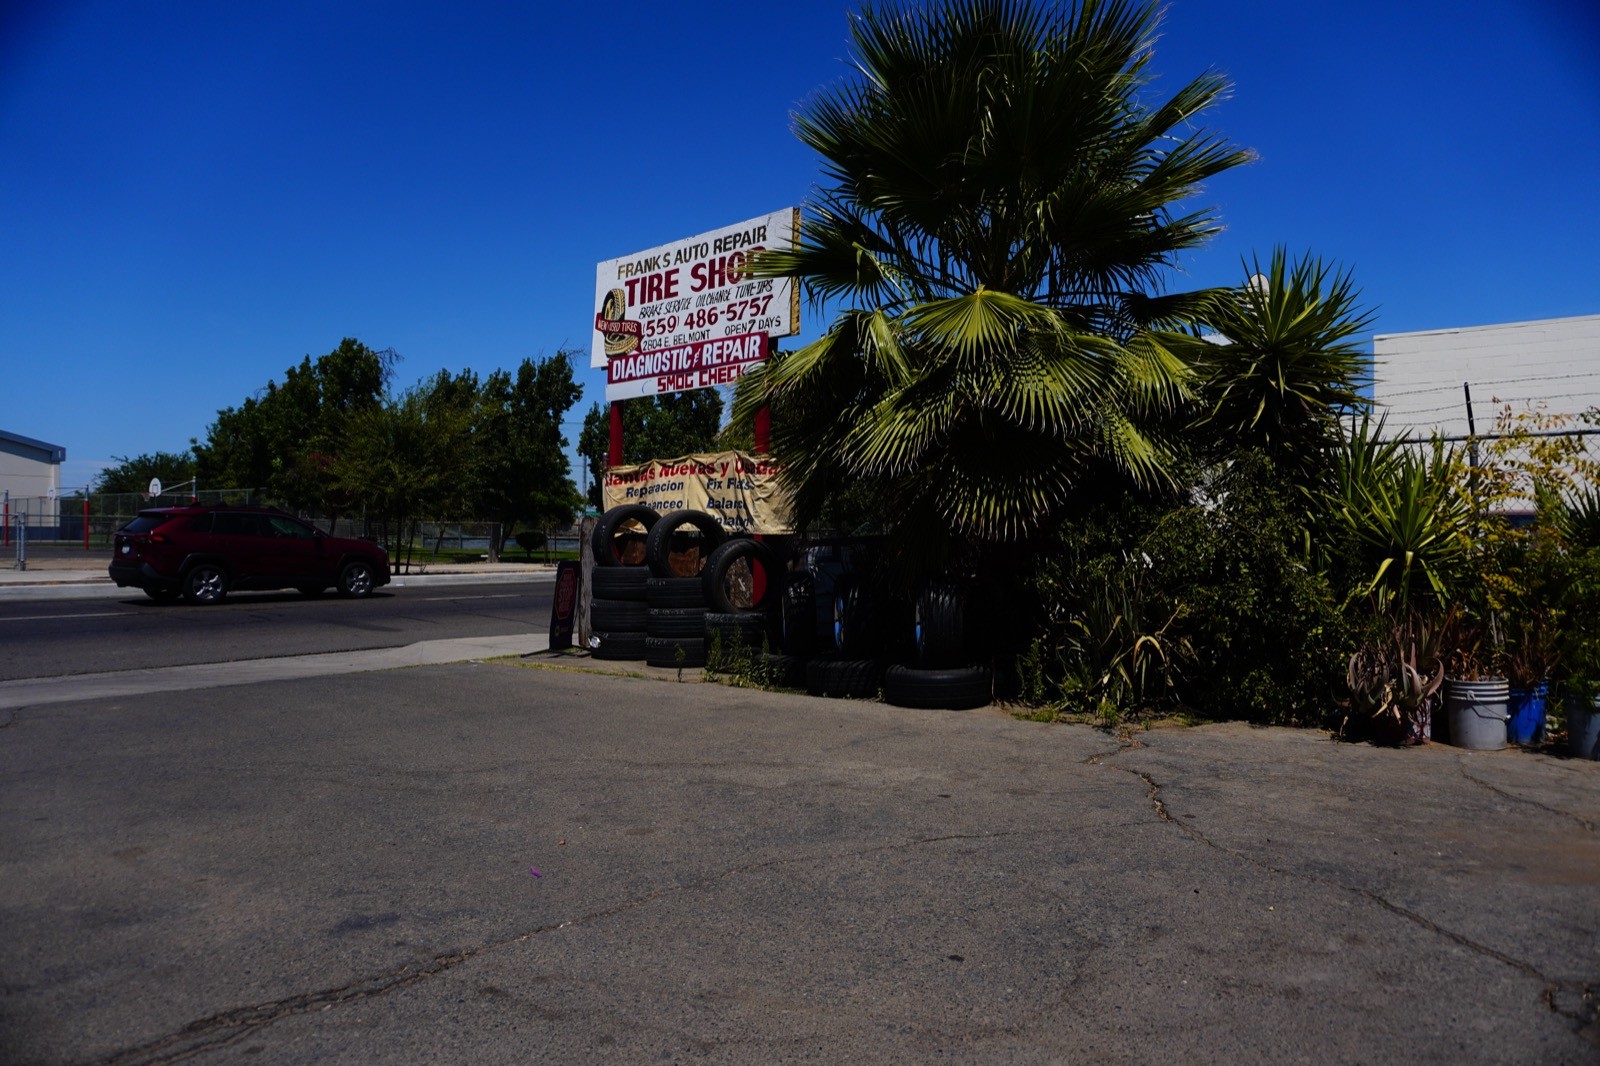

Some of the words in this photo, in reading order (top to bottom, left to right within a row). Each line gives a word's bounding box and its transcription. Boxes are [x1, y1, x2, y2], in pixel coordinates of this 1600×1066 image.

[673, 242, 709, 266] AUTO
[713, 225, 767, 255] REPAIR
[624, 268, 680, 307] TIRE
[639, 303, 664, 319] BRAKE
[663, 296, 693, 315] SERVICE
[642, 315, 680, 338] (559)
[683, 294, 774, 331] 486-5757
[621, 321, 638, 333] TIRES
[724, 322, 748, 336] OPEN
[747, 319, 757, 334] 7
[758, 315, 782, 330] DAYS
[642, 338, 663, 351] 2804
[673, 329, 711, 346] BELMONT
[612, 346, 693, 381] DIAGNOSTIC
[701, 335, 762, 366] REPAIR
[657, 372, 694, 392] SMOG
[720, 462, 729, 478] y
[707, 479, 722, 490] Fix
